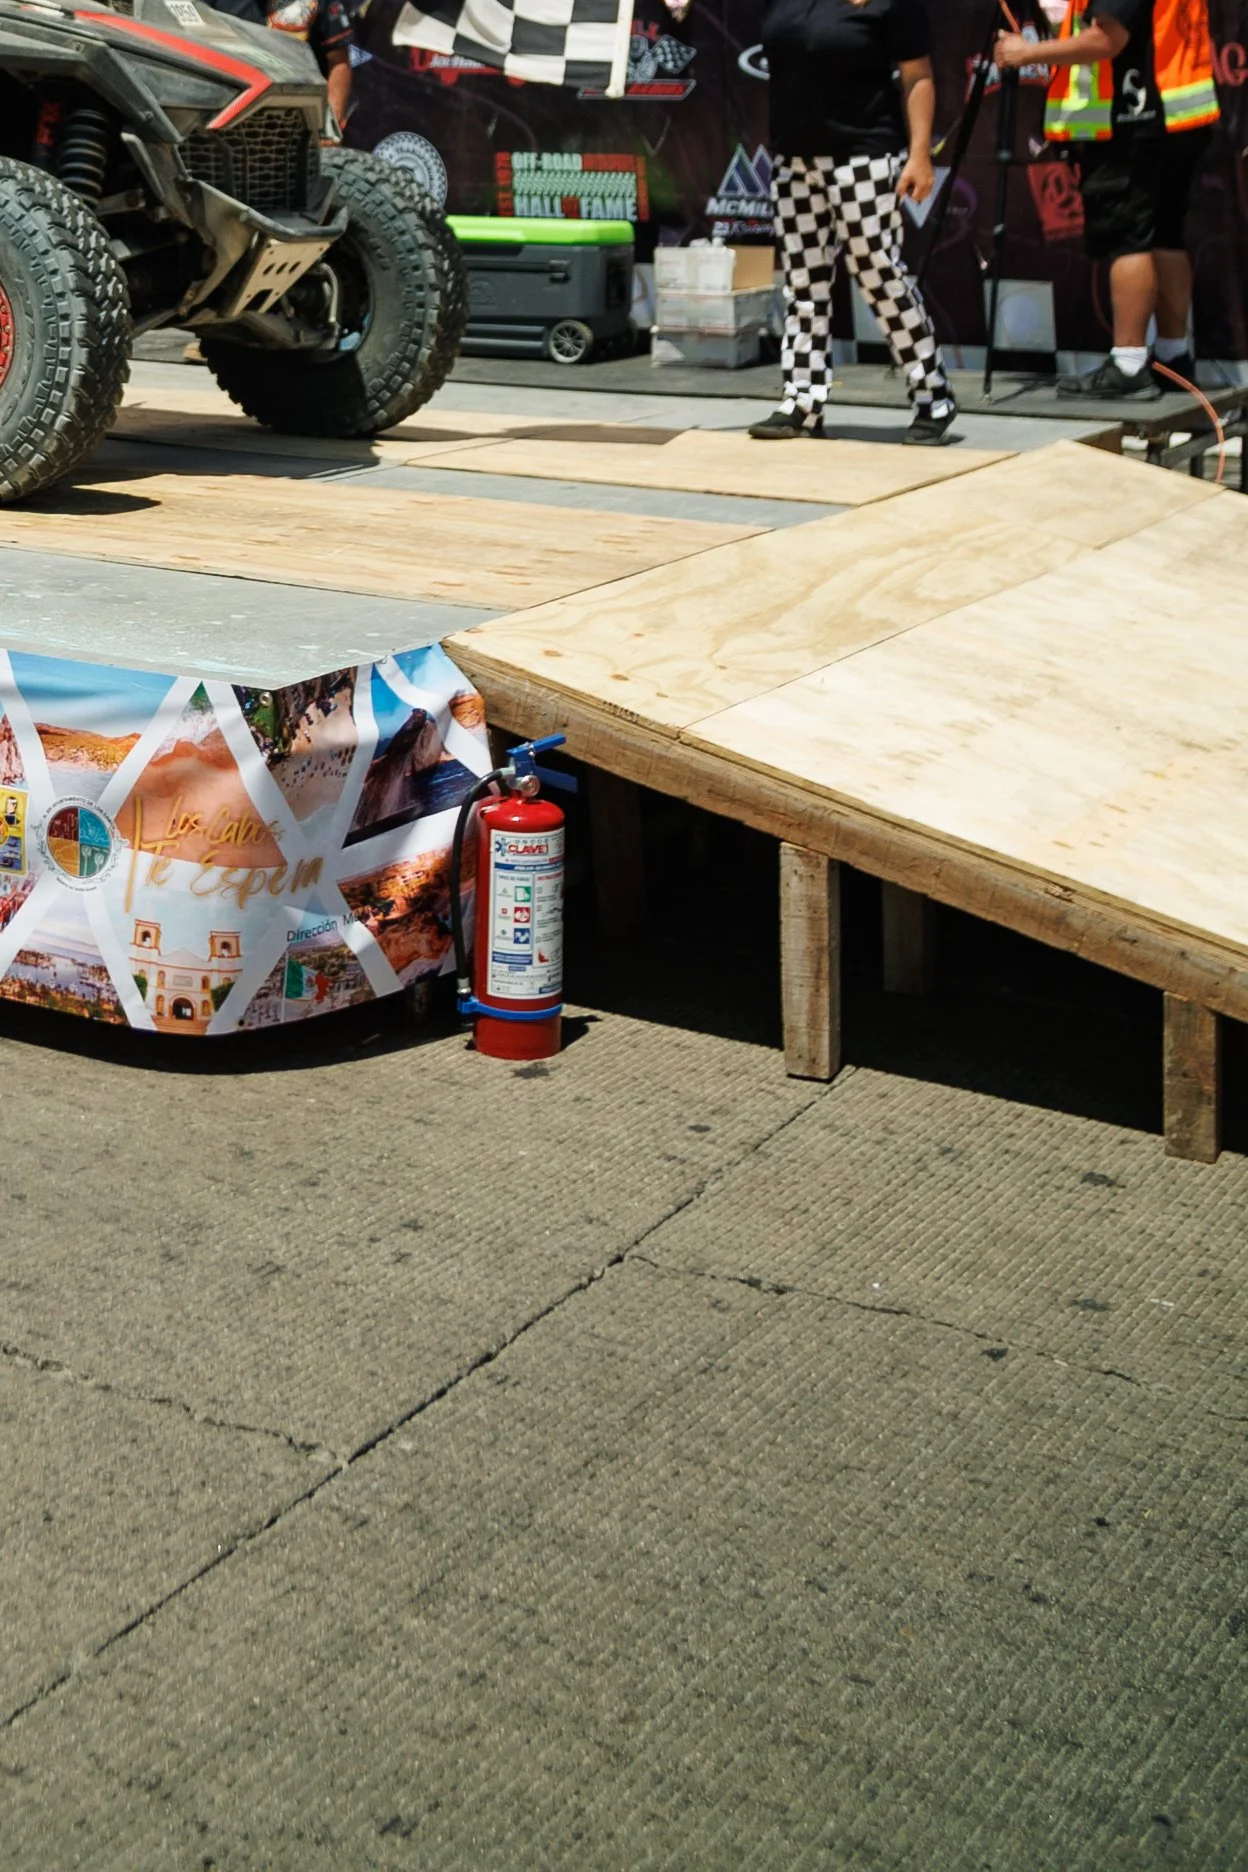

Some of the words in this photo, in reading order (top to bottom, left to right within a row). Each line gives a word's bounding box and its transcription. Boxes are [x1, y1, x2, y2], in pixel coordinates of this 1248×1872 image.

[512, 152, 582, 170] OFF-ROAD
[514, 195, 564, 218] HALL
[580, 196, 637, 221] FAME
[166, 796, 203, 839] Los
[205, 806, 286, 847] Cabos
[140, 839, 180, 888] Te
[190, 850, 324, 910] Espera
[286, 919, 338, 943] Dirección
